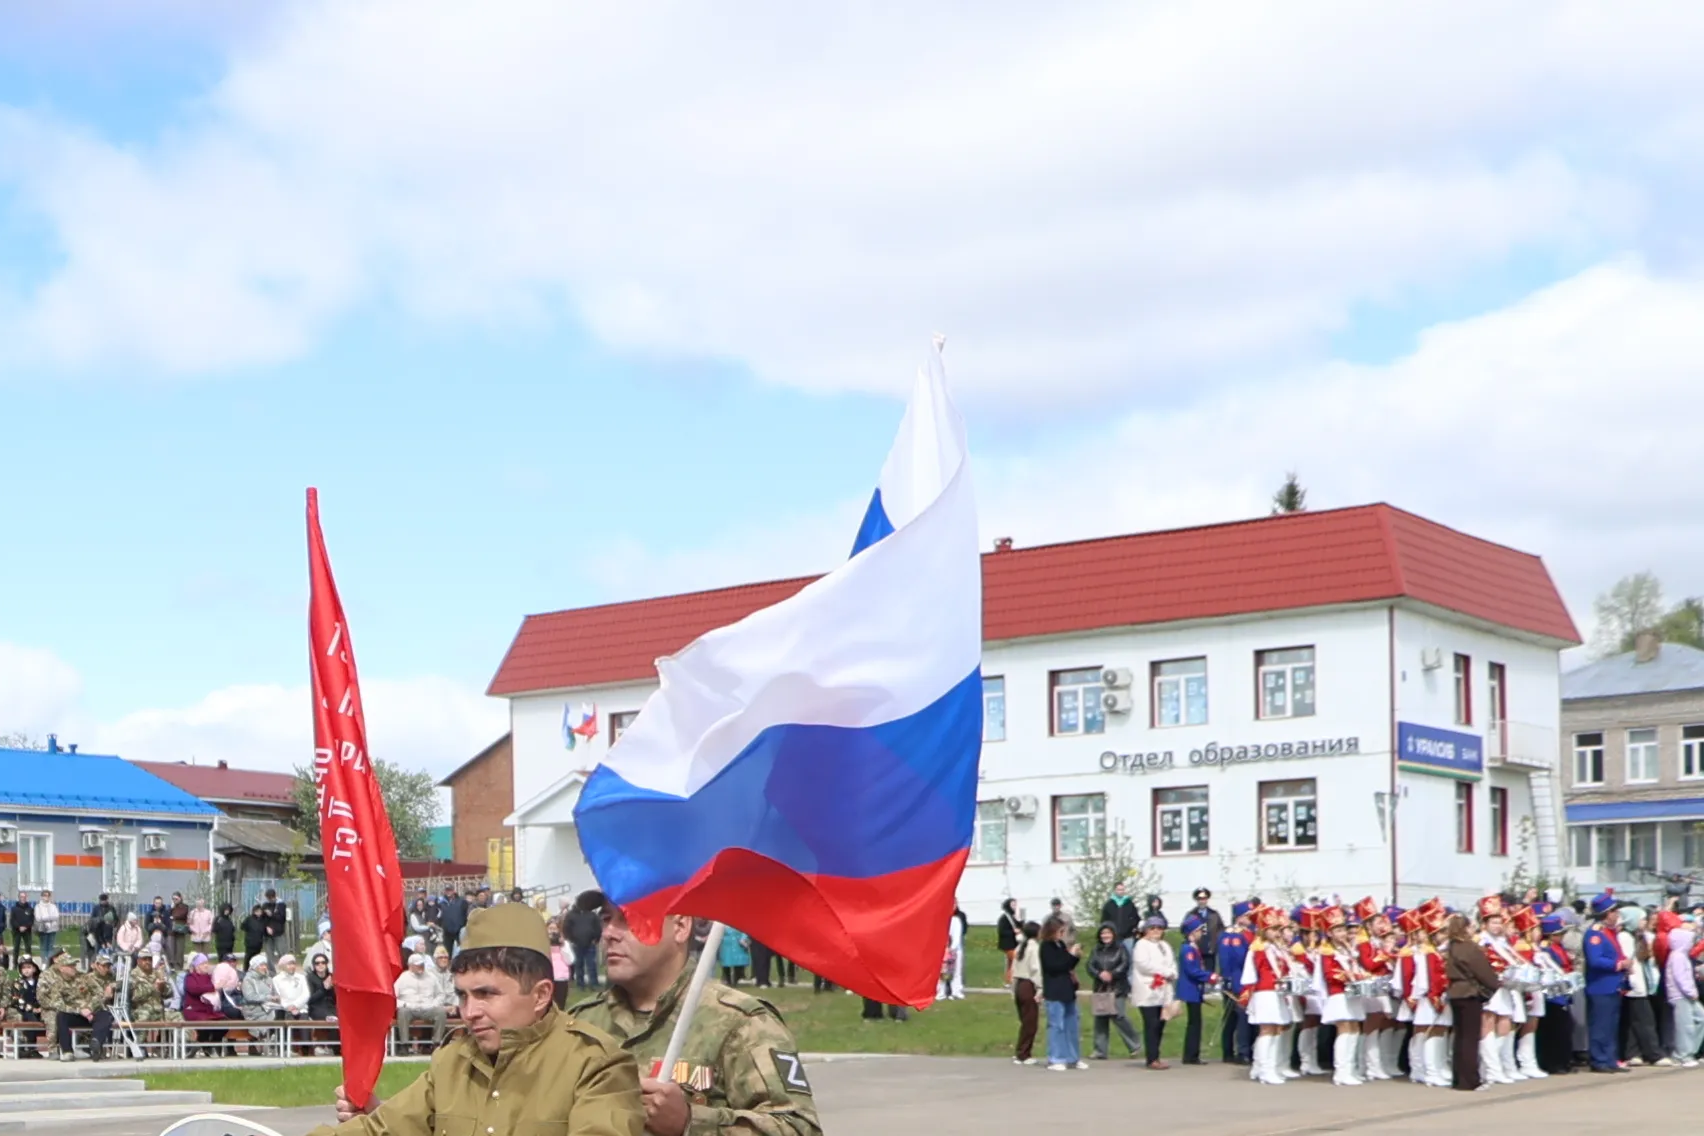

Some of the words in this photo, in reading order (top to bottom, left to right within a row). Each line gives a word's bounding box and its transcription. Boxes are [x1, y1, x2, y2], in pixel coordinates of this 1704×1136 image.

[1099, 750, 1174, 773] Отдел
[1188, 736, 1360, 769] образования
[776, 1054, 808, 1087] Z
